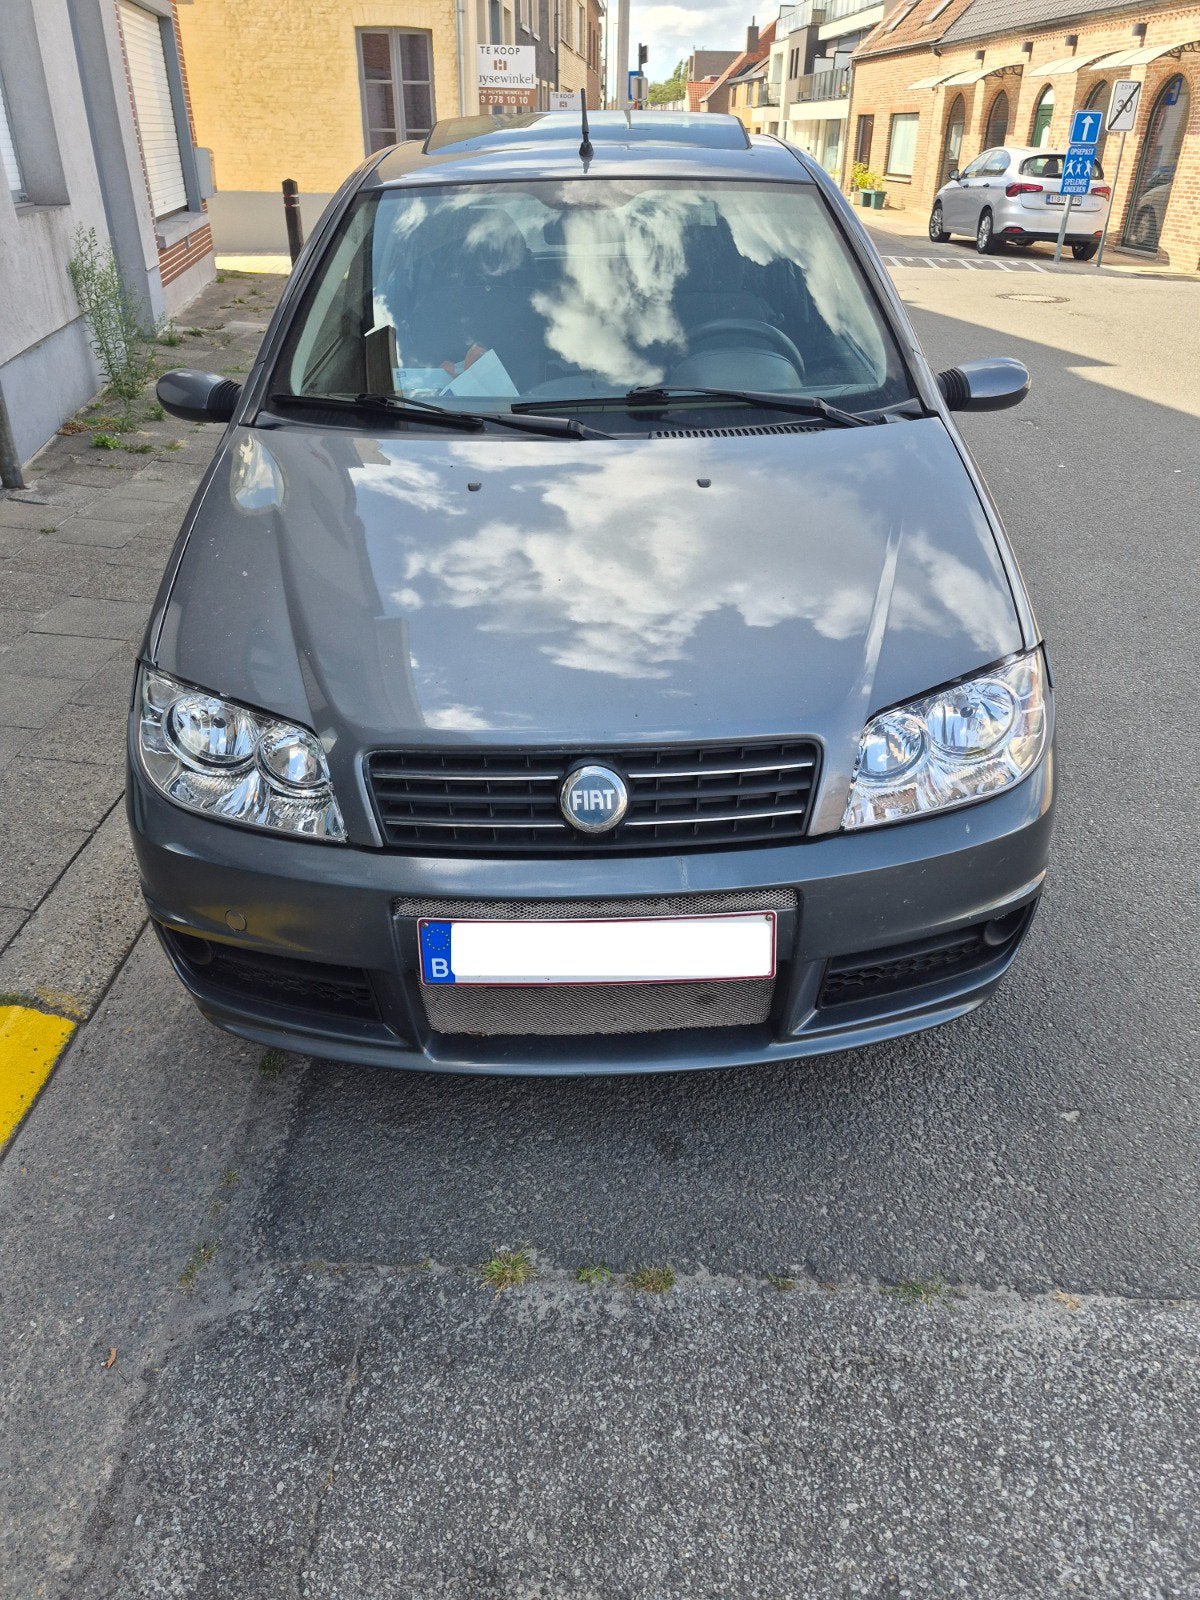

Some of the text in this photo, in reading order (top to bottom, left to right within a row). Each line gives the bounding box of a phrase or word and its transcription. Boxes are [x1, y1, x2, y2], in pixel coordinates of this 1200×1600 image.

[480, 46, 520, 55] TE KOOP
[489, 95, 504, 104] 278
[507, 96, 516, 104] 10
[519, 96, 529, 104] 10
[1116, 99, 1133, 113] 30
[1064, 178, 1088, 186] SPELENDE
[1062, 185, 1086, 193] KINDEREN
[572, 790, 615, 810] FIAT
[431, 957, 449, 978] B
